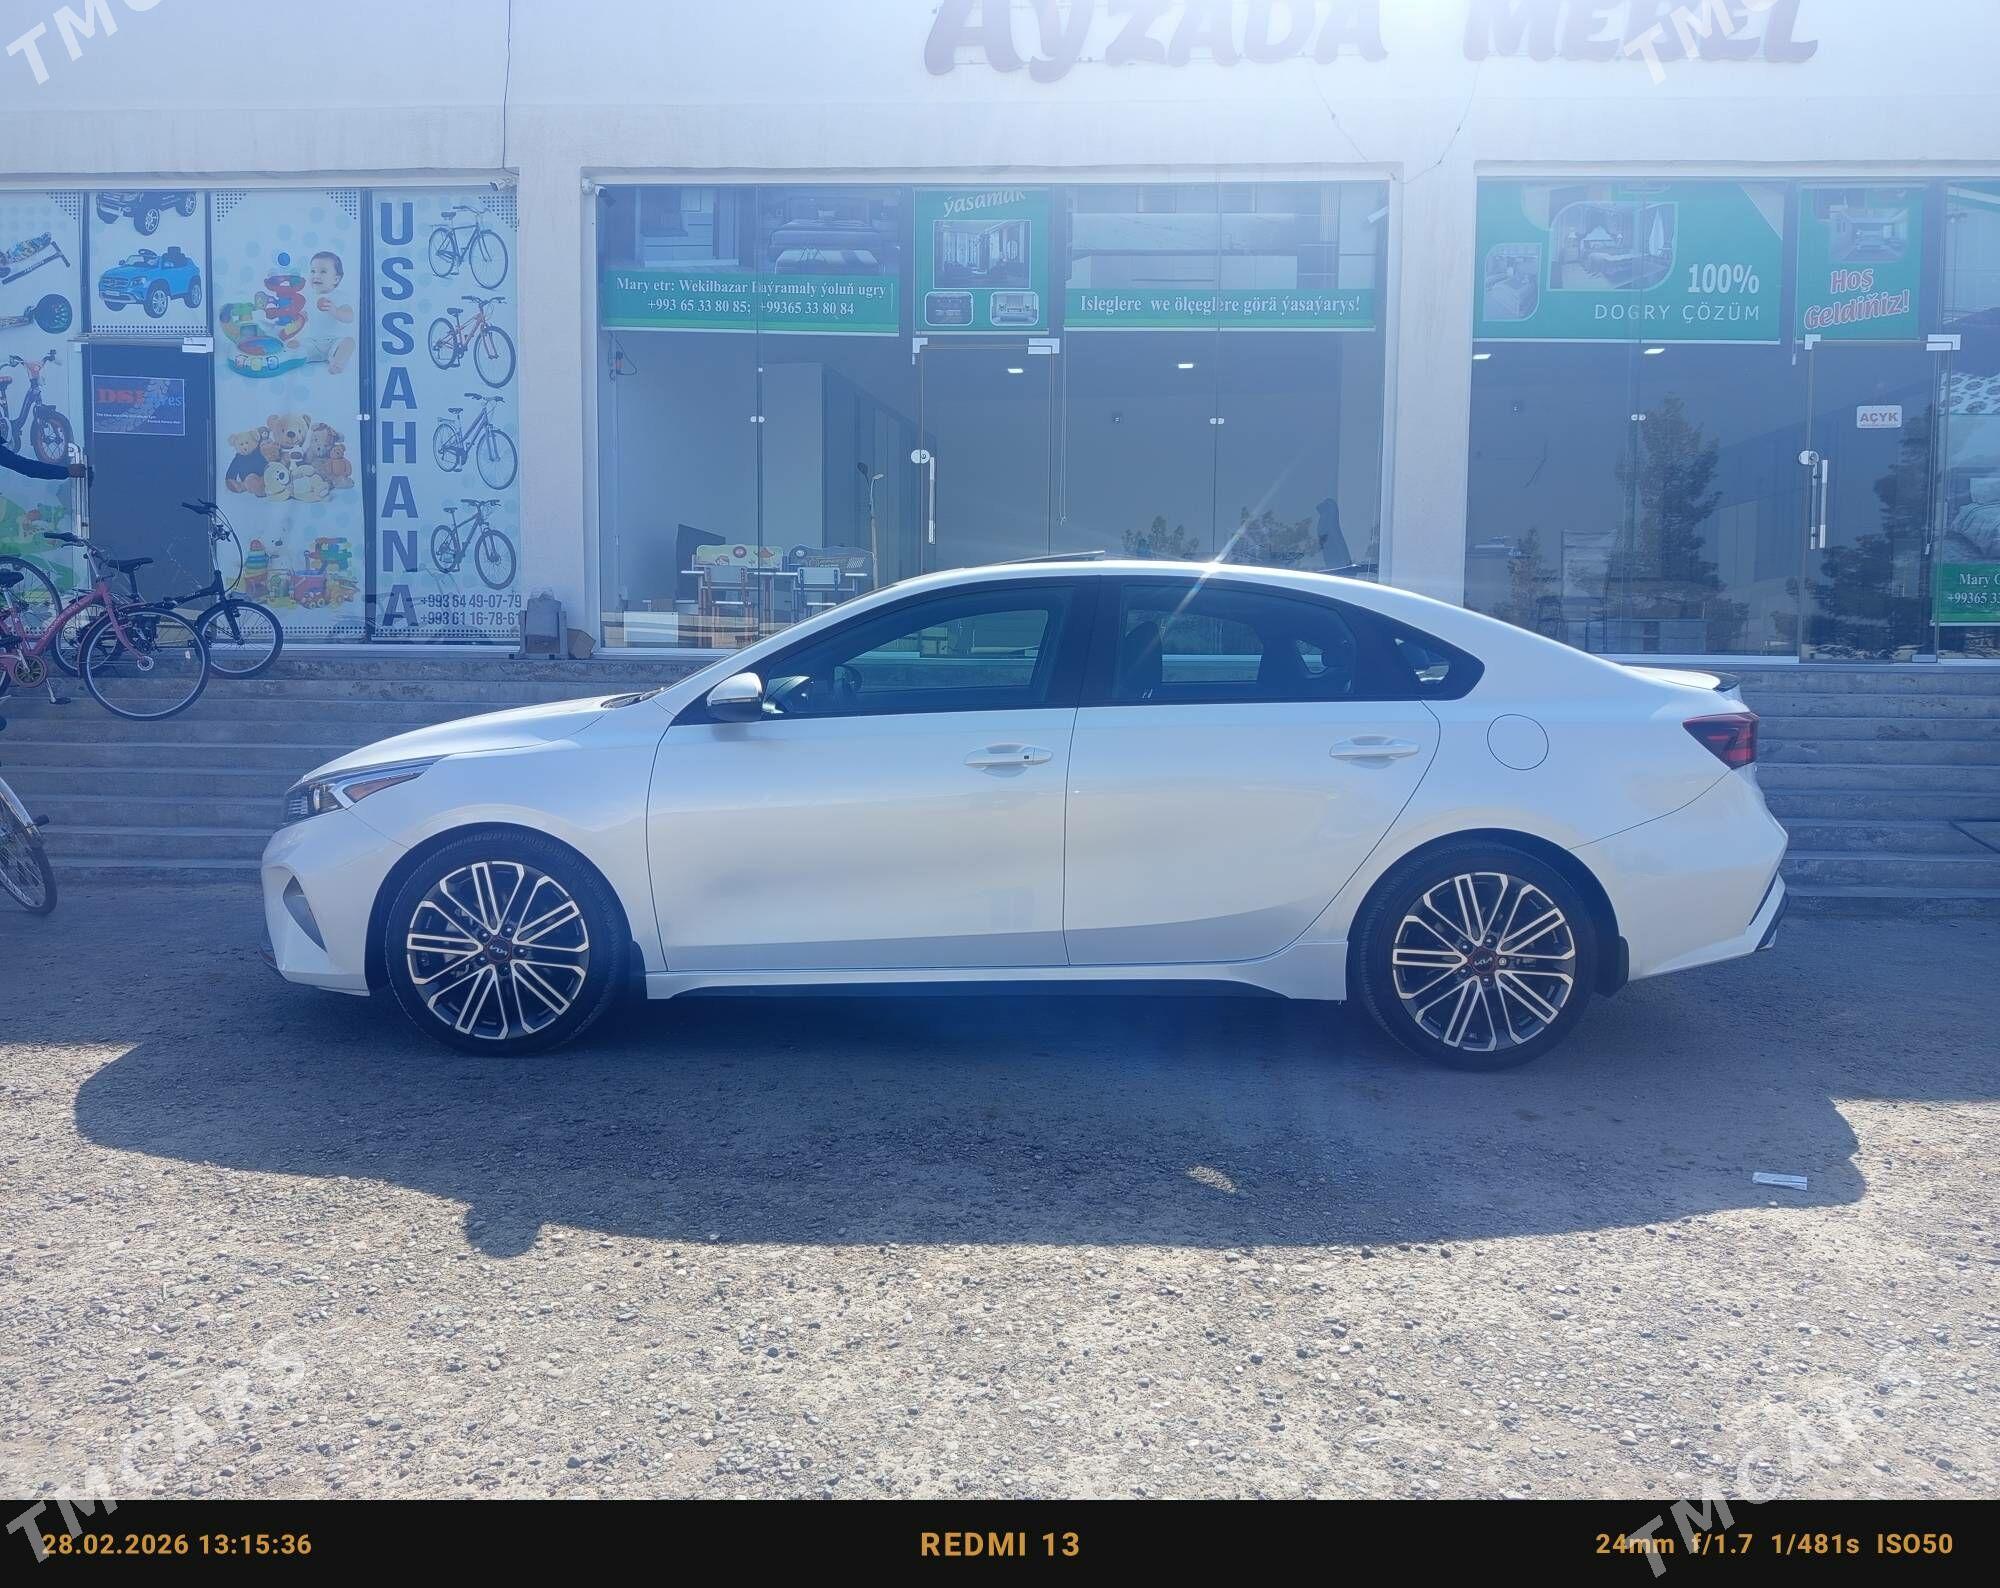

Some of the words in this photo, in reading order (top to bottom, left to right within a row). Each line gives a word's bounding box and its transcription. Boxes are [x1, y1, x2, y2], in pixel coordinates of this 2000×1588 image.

[617, 277, 649, 293] Mary
[654, 281, 675, 291] etr:
[679, 280, 748, 293] Wekilbazar
[859, 286, 886, 298] ugry
[1688, 263, 1760, 294] 100%
[1830, 268, 1874, 294] Hoş
[648, 298, 676, 312] +993
[681, 299, 694, 312] 65
[697, 299, 711, 312] 33
[715, 300, 729, 312] 80
[733, 300, 751, 313] 85;
[760, 301, 801, 314] +99365
[805, 301, 819, 313] 33
[823, 302, 836, 314] 80
[840, 302, 855, 314] 84
[1081, 295, 1141, 315] Isleglere
[1151, 299, 1170, 311] we
[1243, 296, 1277, 315] görä
[1594, 304, 1671, 320] DOGRY
[1682, 301, 1759, 323] ÇÖZÜM
[380, 202, 419, 627] USSAHANA
[1959, 573, 1990, 588] Mary
[421, 594, 449, 608] +993
[469, 594, 521, 608] 49-07-79
[1946, 591, 1988, 604] +99365
[421, 611, 449, 625] +993
[452, 611, 465, 625] 61
